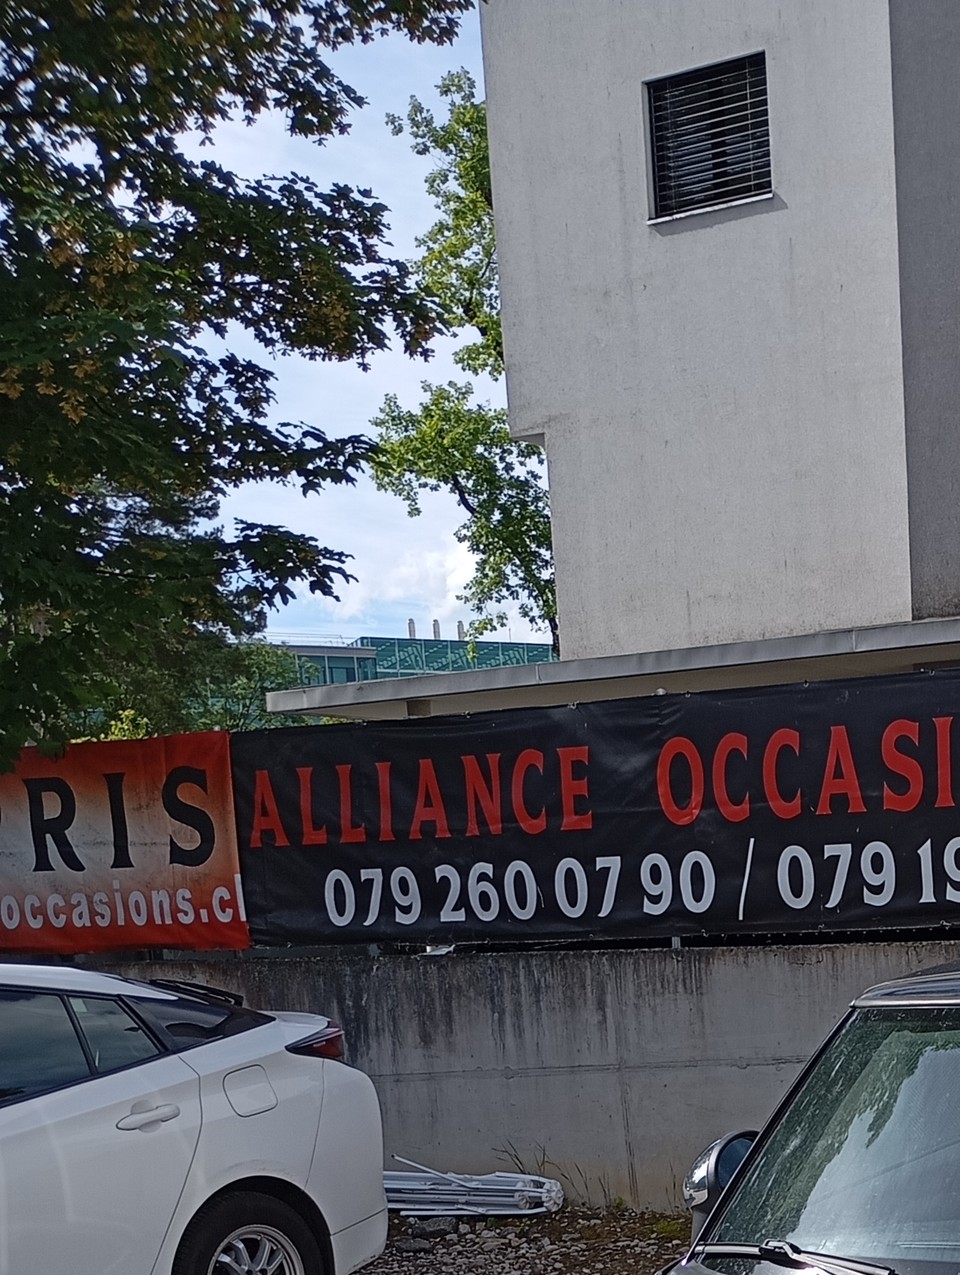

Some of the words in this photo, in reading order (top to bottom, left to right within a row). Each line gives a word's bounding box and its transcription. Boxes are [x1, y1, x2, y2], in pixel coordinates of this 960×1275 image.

[23, 765, 216, 872] RIS
[249, 746, 593, 849] ALLIANCE
[324, 866, 422, 927] 079
[434, 859, 538, 921] 260
[554, 856, 622, 919] 07
[639, 849, 716, 916] 90
[738, 837, 755, 921] /
[776, 840, 897, 910] 079
